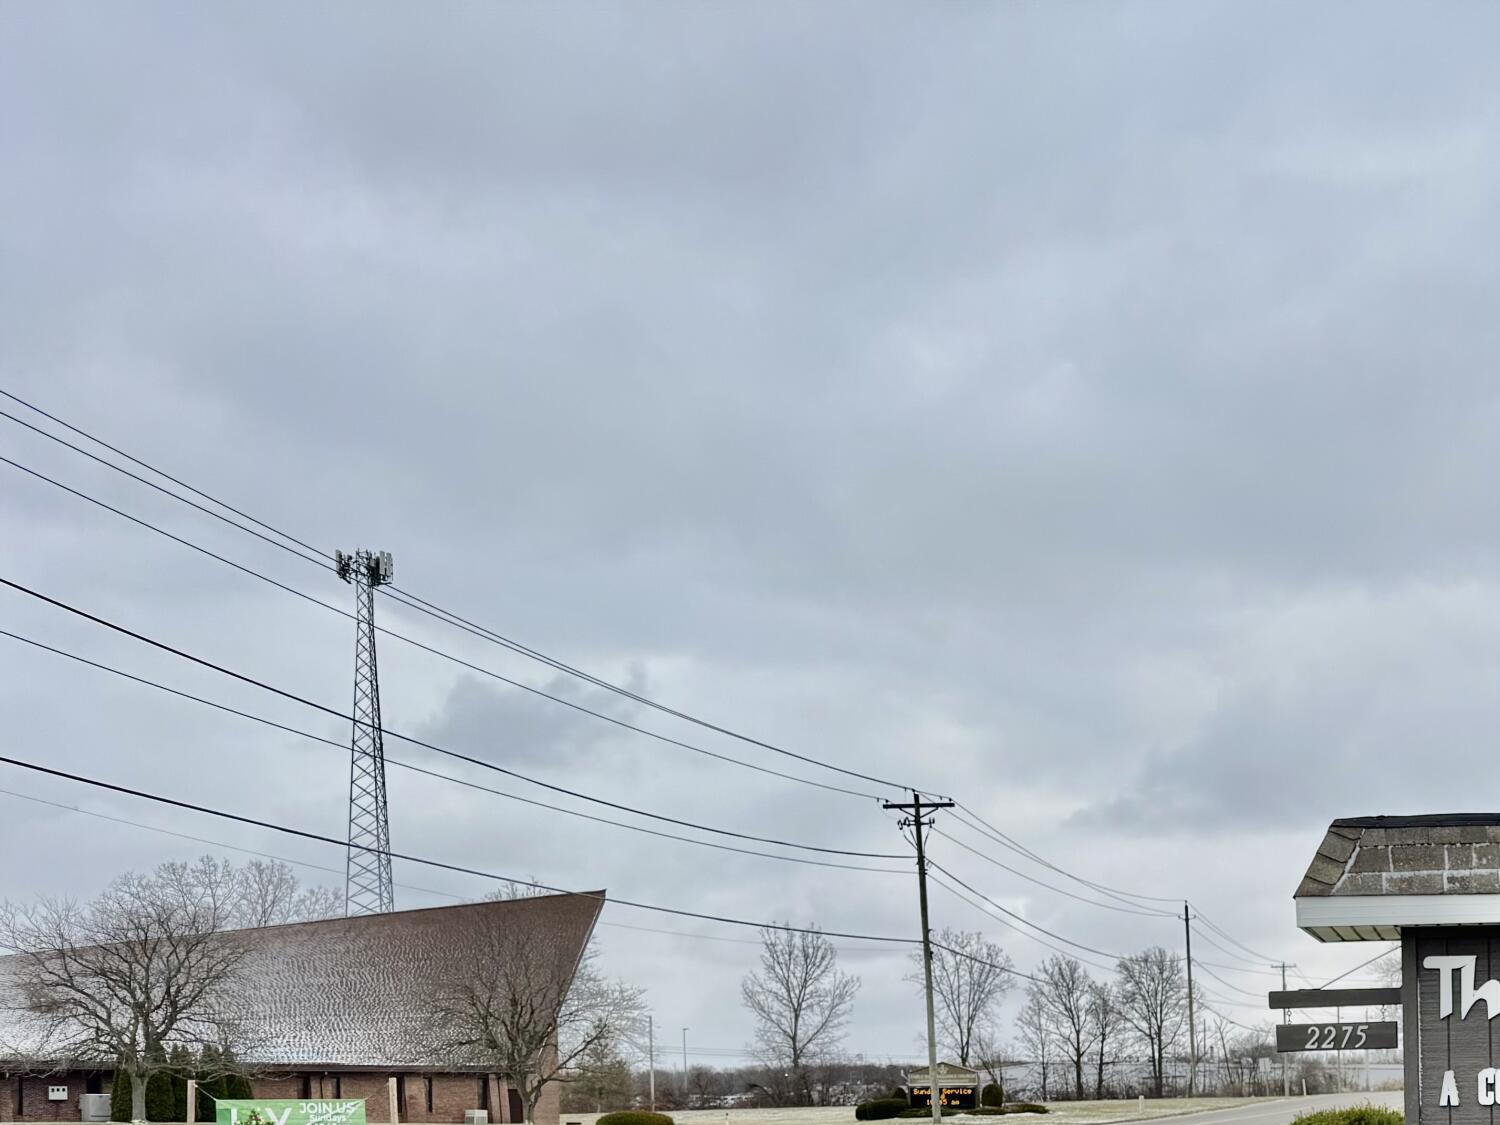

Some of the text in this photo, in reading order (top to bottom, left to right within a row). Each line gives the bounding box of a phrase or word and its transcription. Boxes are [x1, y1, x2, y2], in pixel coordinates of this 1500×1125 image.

[1305, 1025, 1369, 1050] 2275
[1439, 1070, 1460, 1106] A
[299, 1102, 355, 1114] JOIN US
[310, 1114, 347, 1123] Sundays
